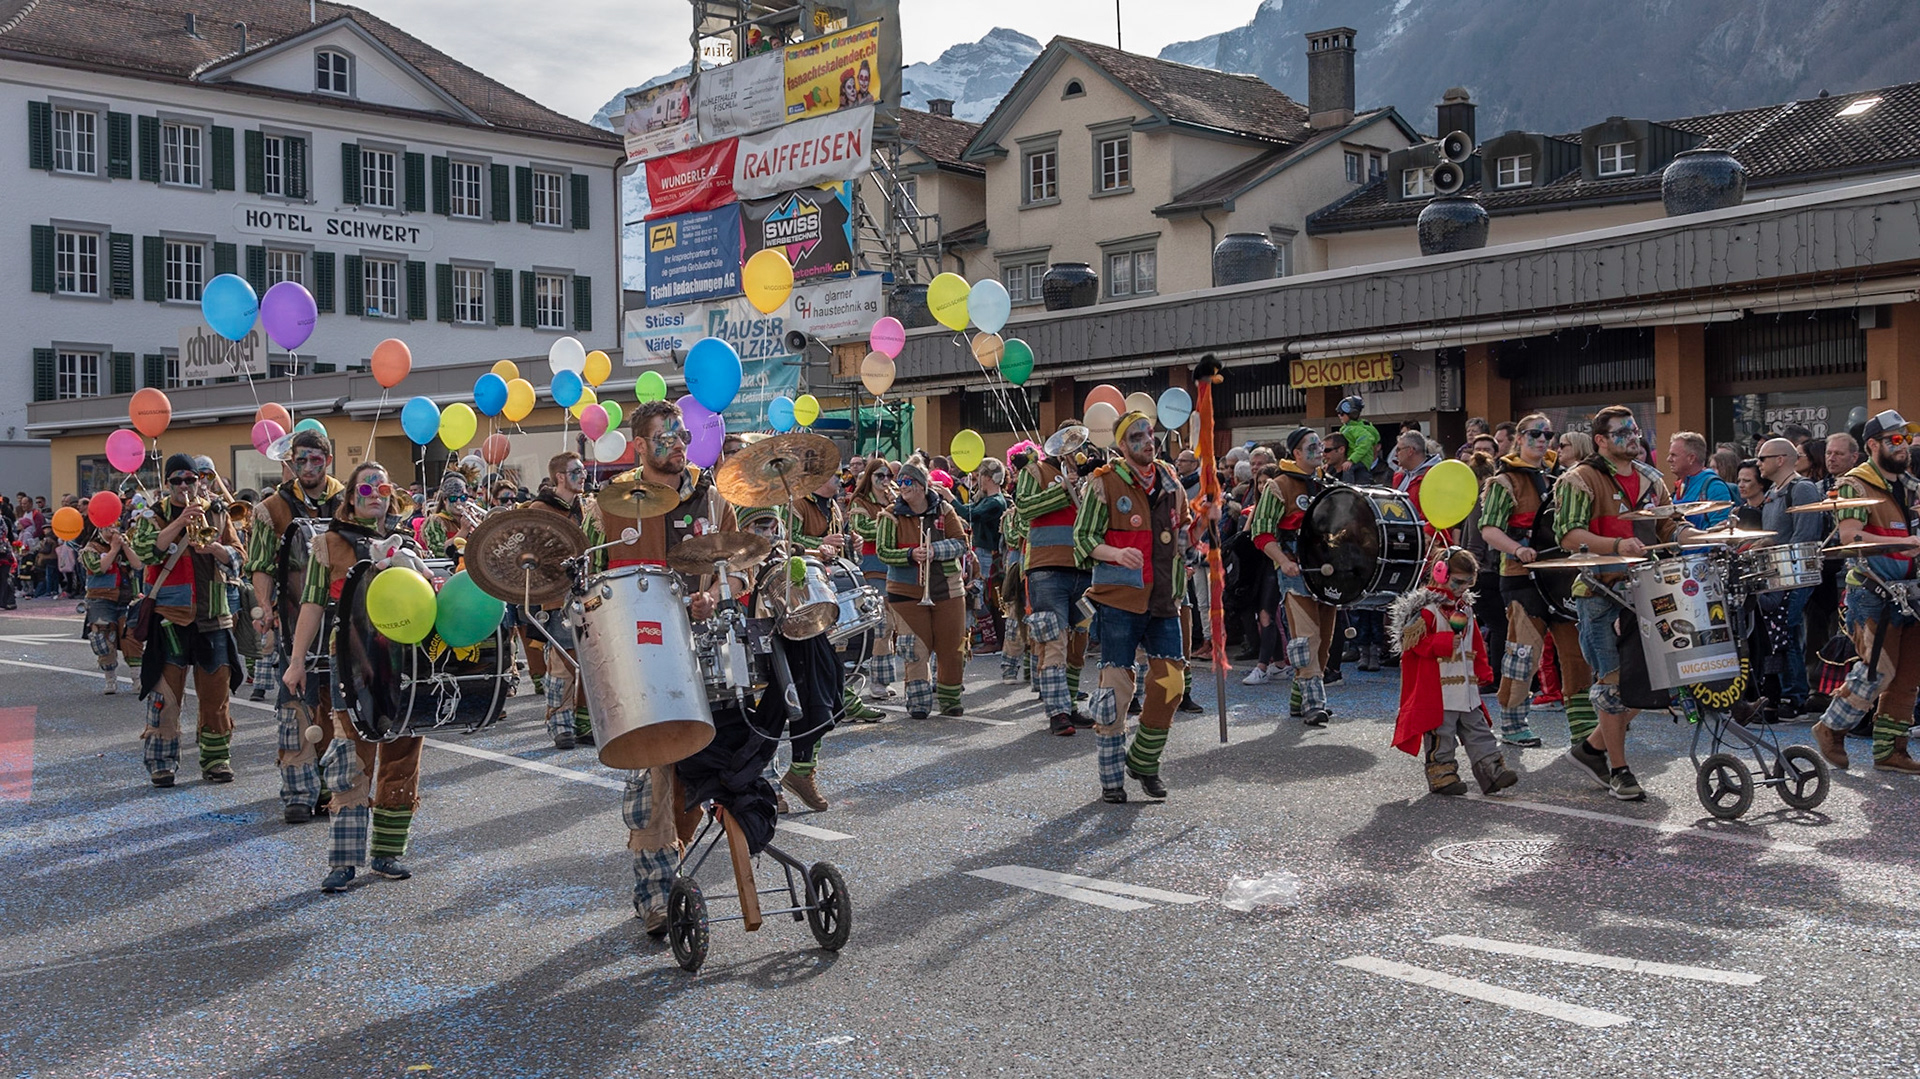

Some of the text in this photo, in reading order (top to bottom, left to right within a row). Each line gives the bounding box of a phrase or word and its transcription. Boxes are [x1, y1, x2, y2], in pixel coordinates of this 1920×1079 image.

[785, 44, 820, 61] Fasnacht
[831, 27, 878, 48] Glarnerland
[787, 41, 877, 91] fasnachtskalender.ch
[743, 129, 862, 180] RAIFFEISEN
[661, 168, 706, 190] WUNDERLE
[706, 164, 718, 177] AG
[246, 209, 420, 244] HOTEL SCHWERT
[765, 214, 818, 239] SWISS
[652, 226, 675, 249] FA
[766, 231, 818, 246] WERBETECHNIK
[671, 249, 710, 263] Ansprechpartner
[669, 265, 687, 277] gesamte
[687, 259, 723, 272] Gebäudehülle
[650, 272, 735, 300] Fischli Bedachungen AG
[824, 289, 853, 305] glarner
[645, 312, 684, 328] Stüssi
[813, 301, 877, 318] haustechnik ag
[717, 317, 783, 341] HAUSER
[809, 319, 858, 332] glarner-haustechnik.ch
[645, 336, 683, 352] Näfels
[185, 369, 209, 377] Kaufhaus
[1291, 354, 1391, 386] Dekoriert
[1440, 373, 1449, 407] BISTRO
[1765, 407, 1828, 423] BISTRO
[1771, 421, 1827, 440] SR
